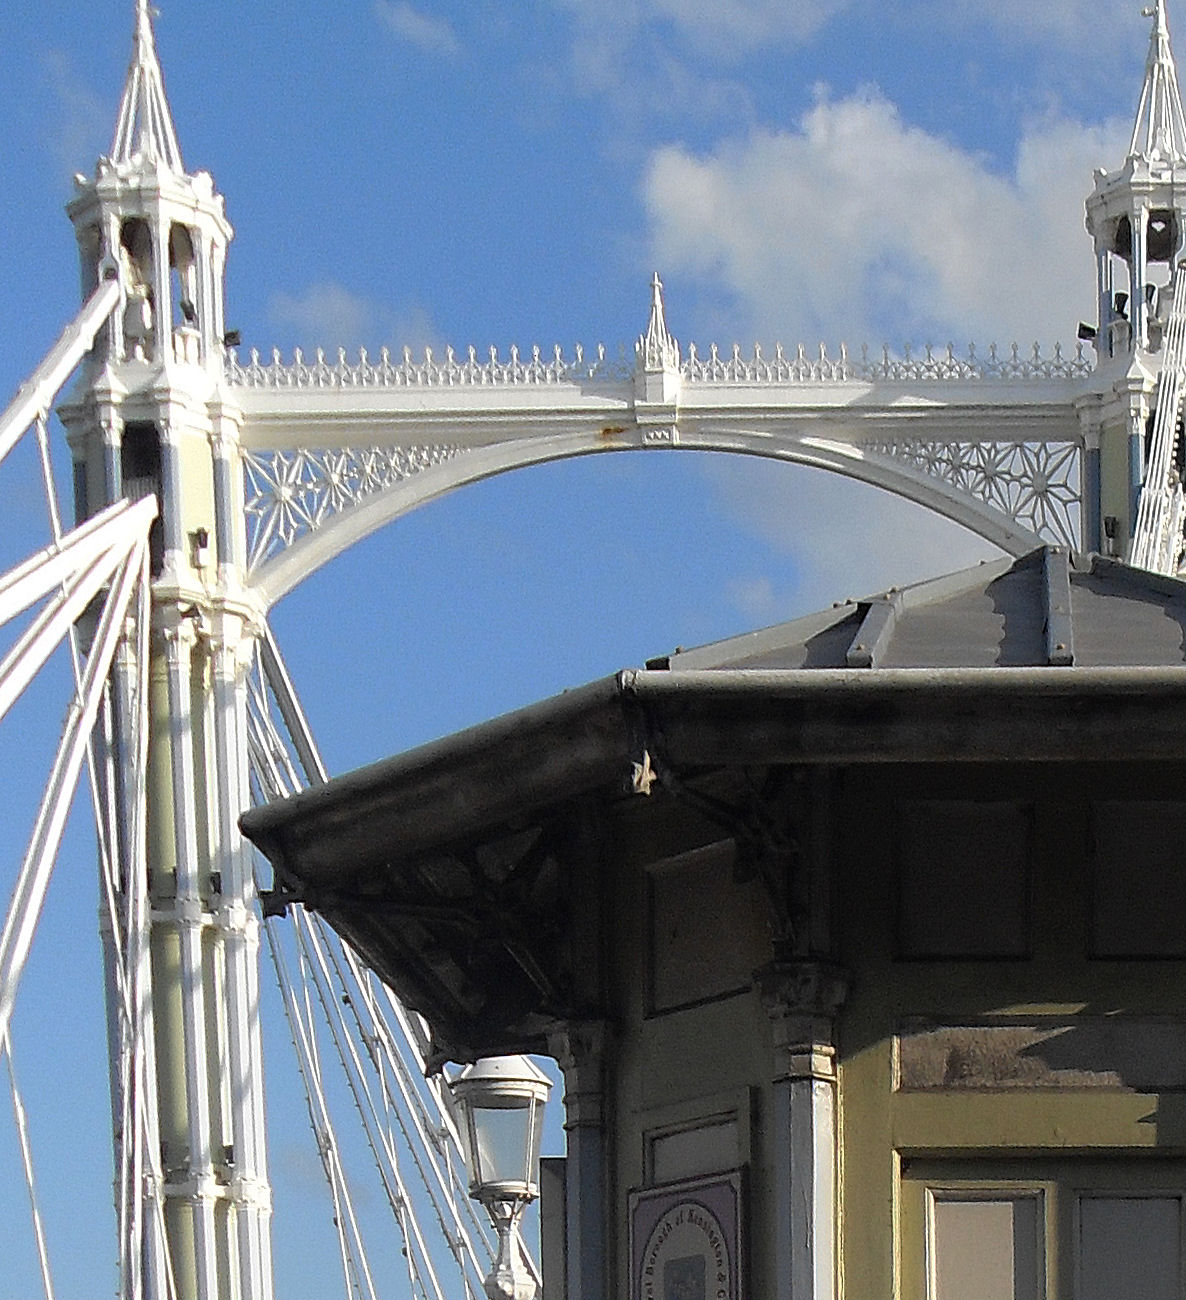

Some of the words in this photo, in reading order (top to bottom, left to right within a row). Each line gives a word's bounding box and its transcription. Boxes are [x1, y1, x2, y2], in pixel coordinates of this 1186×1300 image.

[645, 1221, 673, 1276] Borough
[675, 1209, 684, 1226] of
[687, 1208, 723, 1268] Kensington
[717, 1271, 726, 1283] &
